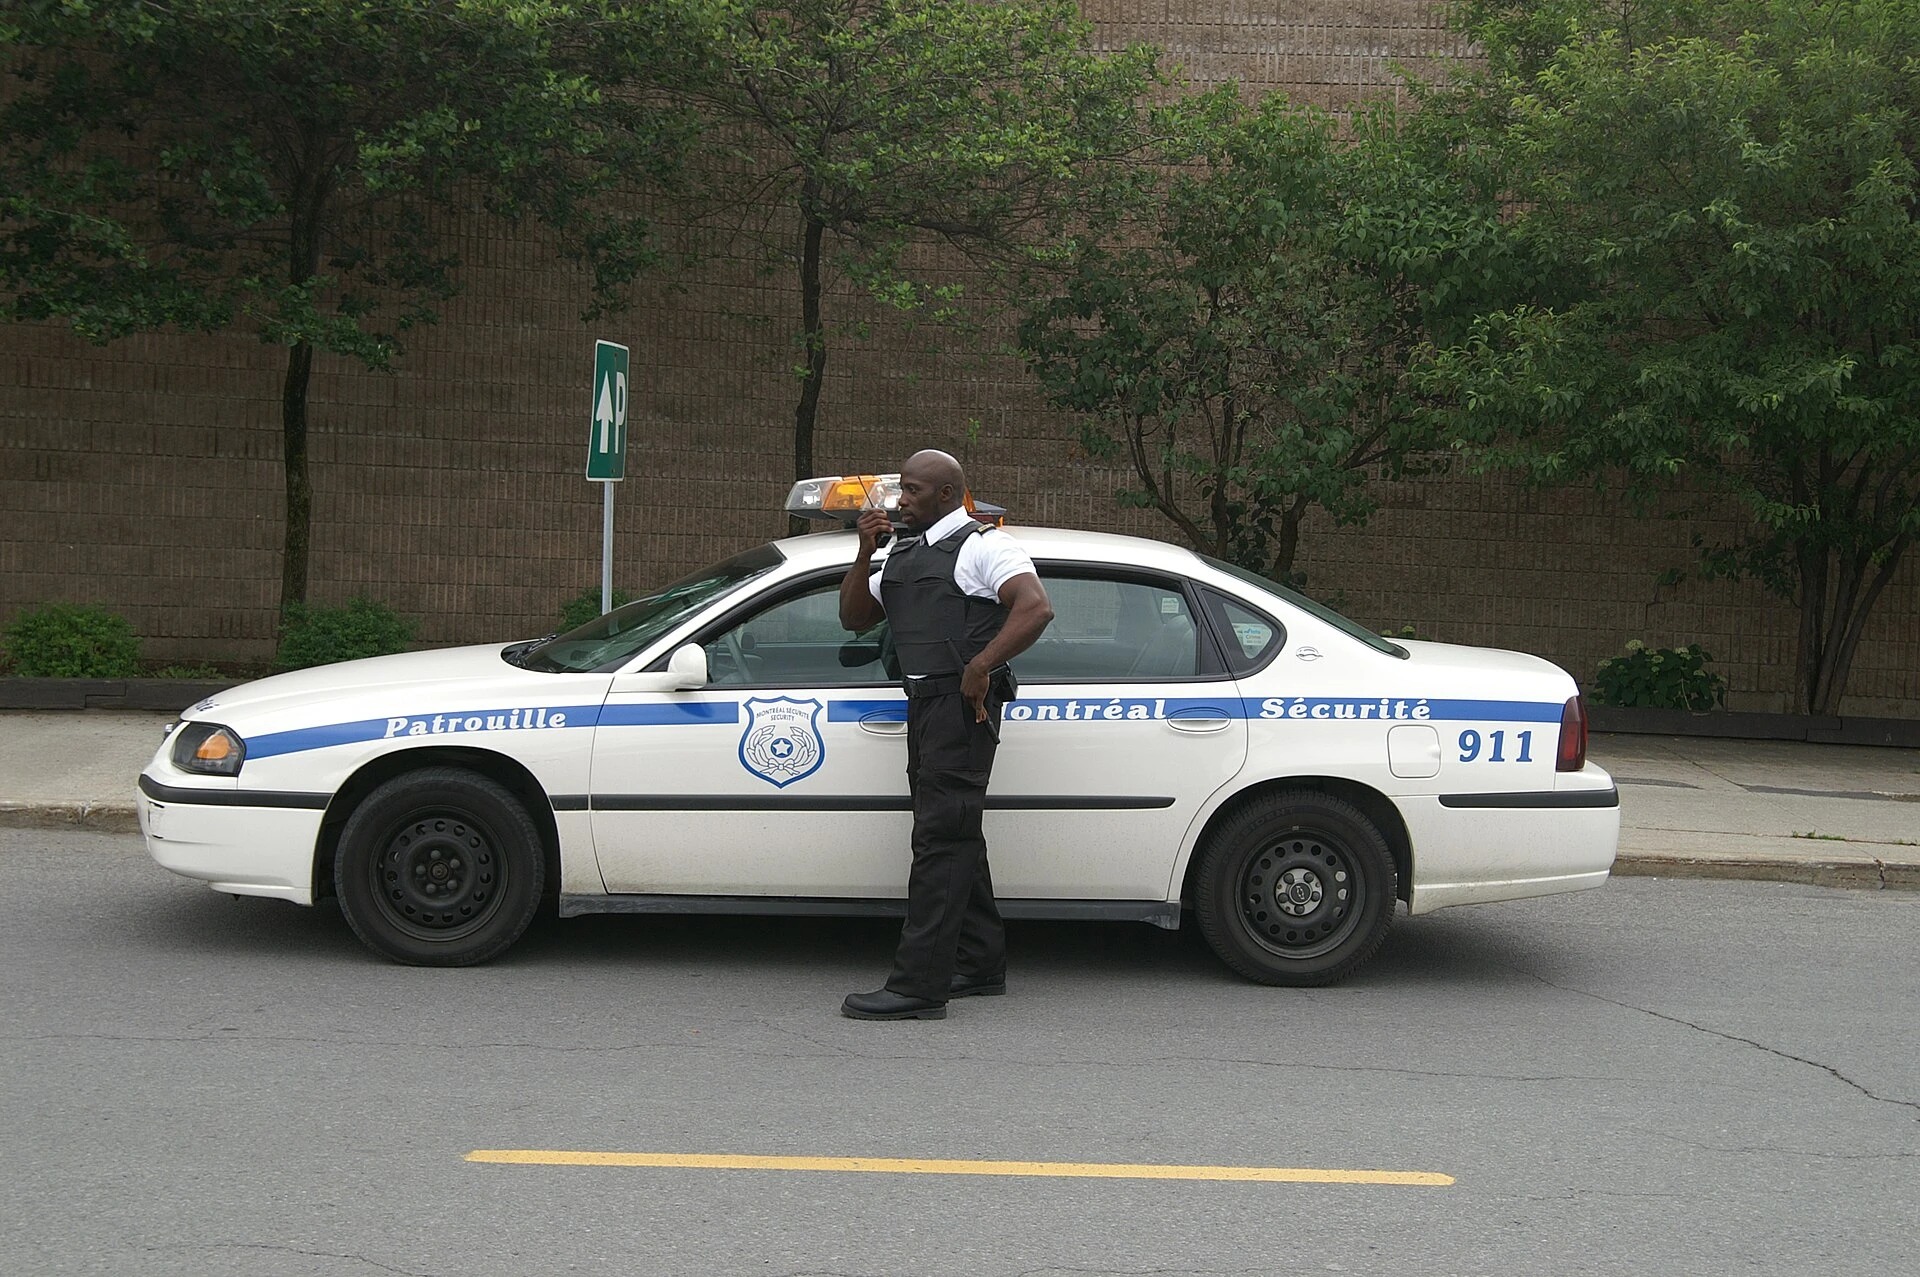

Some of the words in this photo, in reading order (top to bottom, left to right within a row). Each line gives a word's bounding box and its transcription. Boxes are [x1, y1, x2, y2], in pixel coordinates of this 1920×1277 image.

[614, 371, 626, 454] P
[383, 708, 566, 739] Patrouille
[1259, 697, 1431, 720] Sécurité
[1458, 729, 1533, 762] 911
